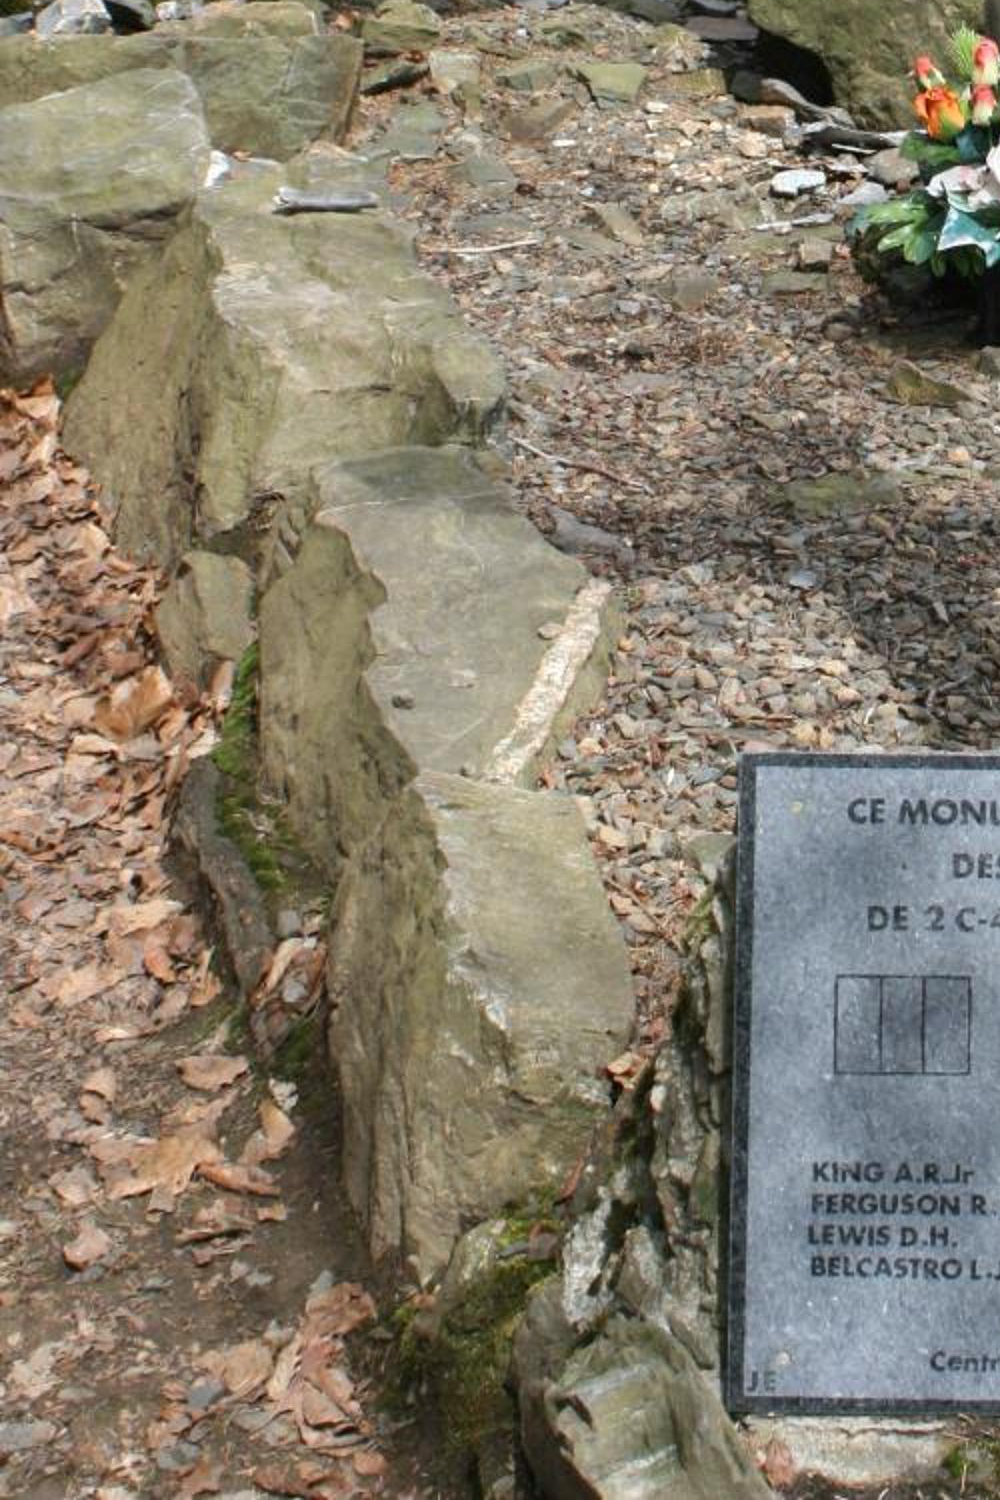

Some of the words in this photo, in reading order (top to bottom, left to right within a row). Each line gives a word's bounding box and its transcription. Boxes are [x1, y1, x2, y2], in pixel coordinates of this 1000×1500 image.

[847, 798, 885, 825] CE
[867, 905, 908, 932] DE
[924, 905, 945, 932] 2
[812, 1161, 884, 1184] KING
[811, 1193, 961, 1217] FERGUSON
[806, 1225, 892, 1246] LEWIS
[810, 1255, 963, 1281] BELCASTRO
